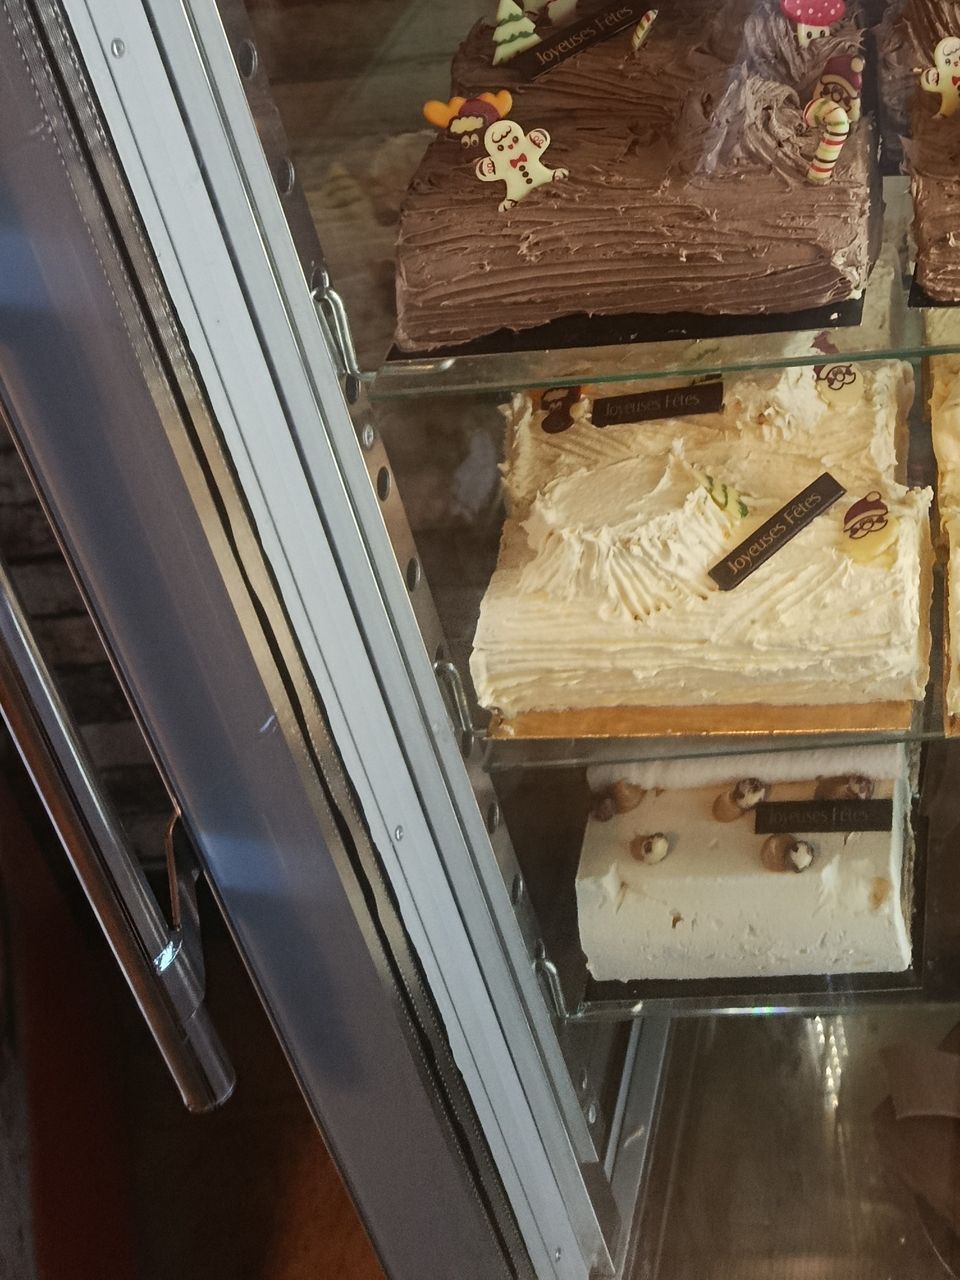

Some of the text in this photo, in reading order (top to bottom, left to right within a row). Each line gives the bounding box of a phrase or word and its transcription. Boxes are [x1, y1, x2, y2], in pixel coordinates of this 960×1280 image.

[536, 24, 597, 66] Joyeuses
[604, 400, 661, 419] Joyeuses
[726, 491, 823, 575] Joyeuses Fêtes
